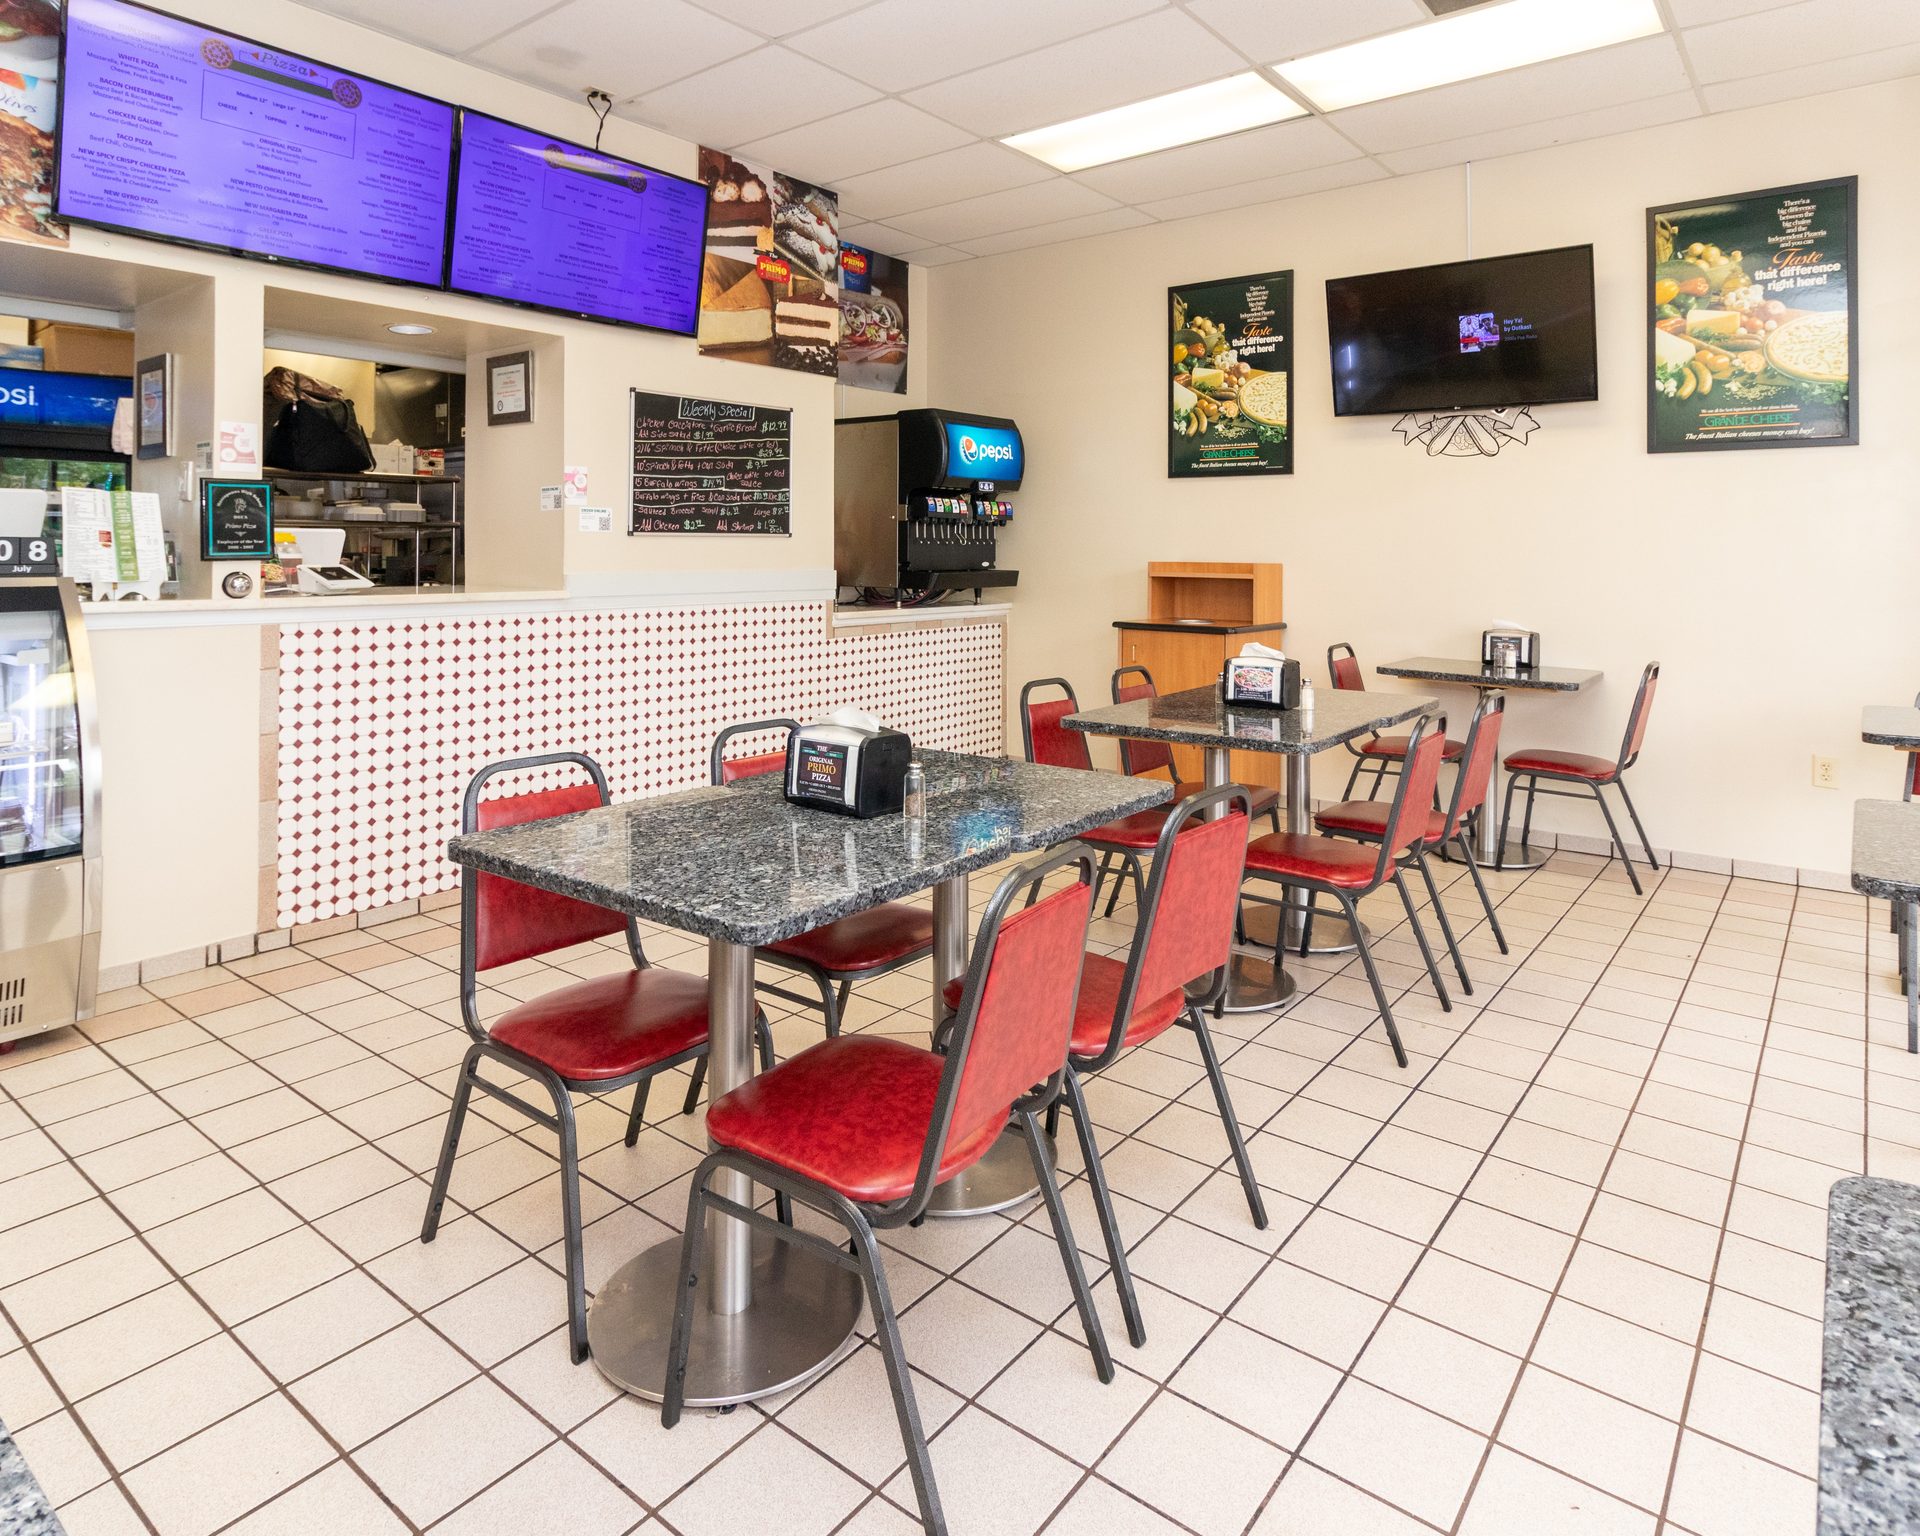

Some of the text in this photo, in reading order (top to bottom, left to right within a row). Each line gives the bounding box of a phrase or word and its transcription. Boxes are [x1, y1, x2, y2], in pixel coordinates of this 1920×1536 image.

[118, 52, 159, 69] WHITE PIZZA
[260, 50, 308, 77] Pizza
[99, 76, 173, 102] BACON CHEESEBURGER
[107, 108, 162, 127] CHICKEN GALORE
[217, 101, 237, 111] CHEESE
[264, 114, 287, 125] TOPPING
[116, 132, 152, 146] TACO PIZZA
[259, 137, 302, 153] ORIGINAL PIZZA
[78, 147, 186, 176] NEW SPICY CRISPY CHICKEN PIZZA
[256, 163, 301, 179] HAWAIIAN STYLE
[103, 188, 158, 205] NEW GYRO PIZZA
[230, 177, 244, 186] NEW
[245, 181, 262, 190] PESTO
[263, 185, 287, 195] CHICKEN
[301, 194, 323, 204] RICOTTA
[1783, 197, 1804, 207] There's
[244, 201, 307, 219] NEW MARGARITA PIZZA
[1777, 203, 1816, 215] big difference
[1779, 212, 1803, 220] between
[1782, 217, 1811, 228] big chains
[1767, 229, 1826, 243] Independent Pizzeria
[1779, 238, 1814, 248] and you can
[843, 256, 865, 268] PRIMO
[1772, 244, 1823, 270] Taste
[760, 262, 787, 276] PRIMO
[1753, 260, 1841, 280] that difference
[1768, 274, 1827, 292] right here!
[1242, 320, 1272, 339] Taste
[1232, 334, 1284, 346] that difference
[1240, 344, 1275, 356] right here!
[682, 400, 716, 420] Weekly
[636, 416, 665, 428] Chicken
[760, 420, 788, 434] $12.99
[1704, 413, 1793, 426] GRANDE CHEESE
[650, 430, 715, 440] Side $1.99
[1738, 430, 1762, 438] cheeses
[980, 444, 1012, 462] pepsi
[1203, 449, 1255, 458] GRANDE CHEESE
[715, 461, 734, 470] Soda
[746, 460, 768, 470] $9.99
[773, 469, 785, 478] Red
[644, 478, 674, 489] Buffalo
[634, 492, 660, 501] Buffalo
[691, 492, 706, 502] Fries
[753, 507, 771, 518] Large
[653, 519, 754, 532] Chicken $2.99 Add Shrimp
[0, 540, 47, 561] 0 8
[12, 565, 32, 573] July
[809, 756, 834, 765] ORIGINAL
[808, 762, 836, 774] PRIMO
[812, 773, 832, 783] PIZZA
